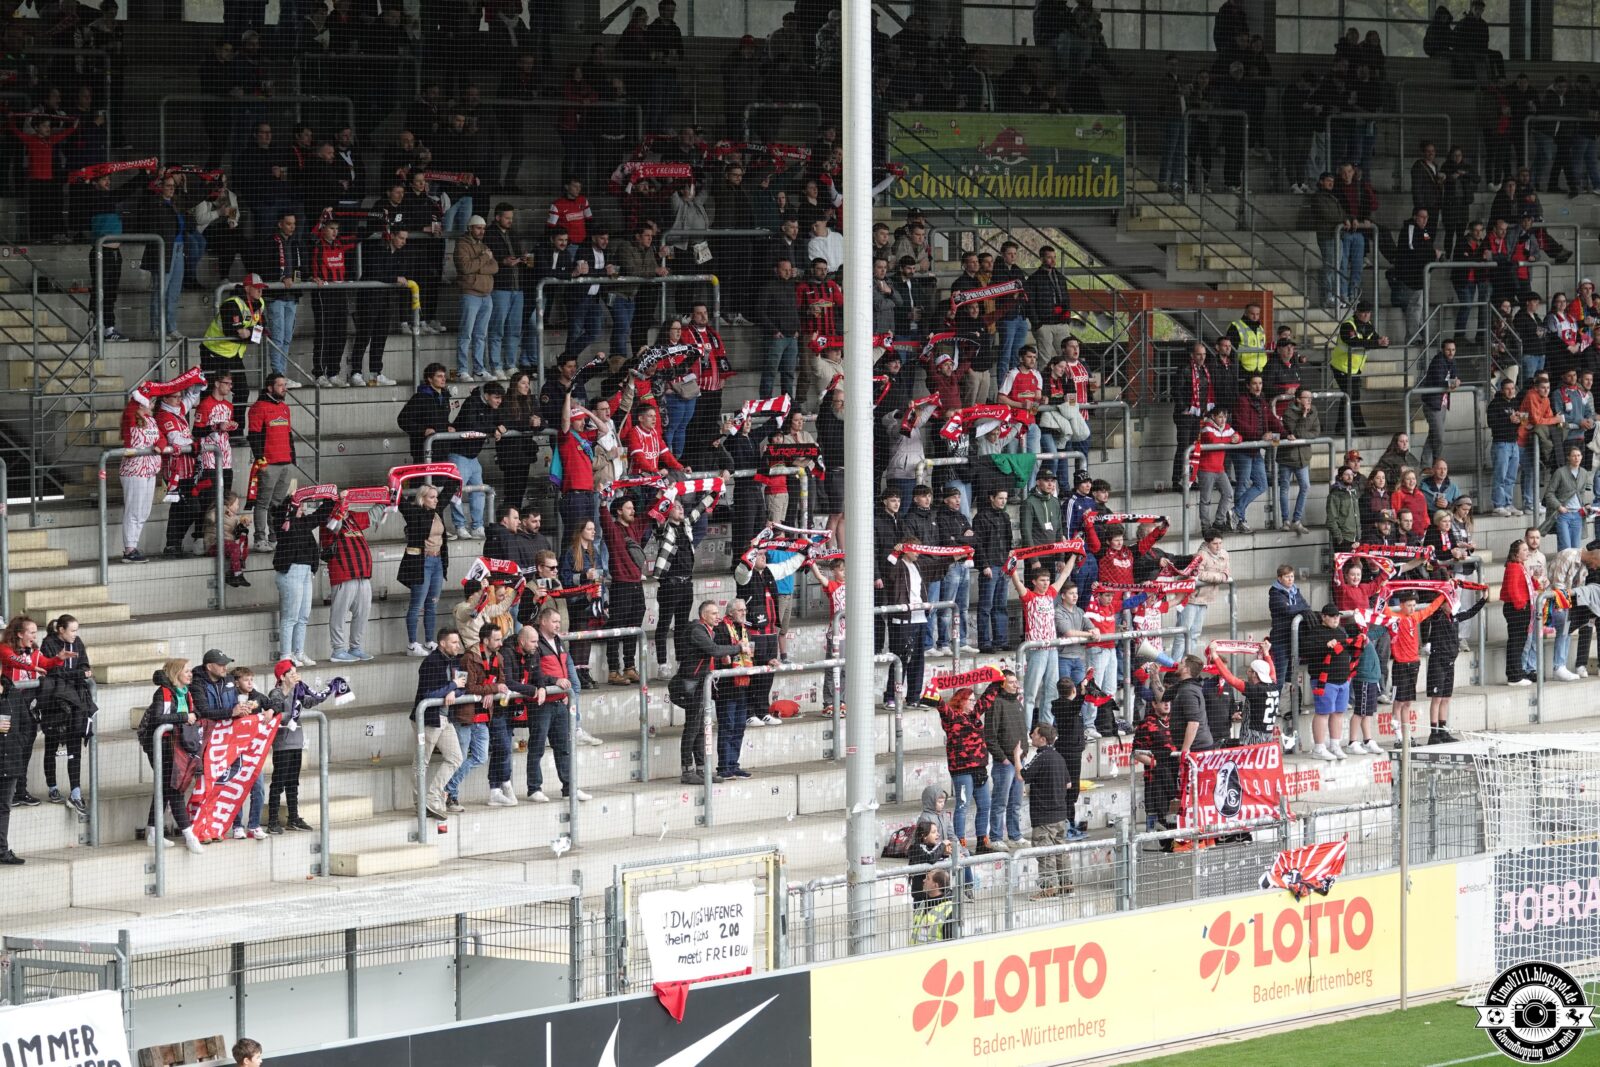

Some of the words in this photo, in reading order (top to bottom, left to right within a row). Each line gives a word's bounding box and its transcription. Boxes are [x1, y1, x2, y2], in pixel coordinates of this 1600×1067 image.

[895, 165, 1119, 198] Schwarzwaldmilch
[1254, 897, 1374, 967] LOTTO
[974, 942, 1107, 1018] LOTTO
[1254, 968, 1373, 1004] Baden-Württemberg
[2, 1025, 98, 1067] IMMER
[974, 1018, 1107, 1057] Baden-Württemberg
